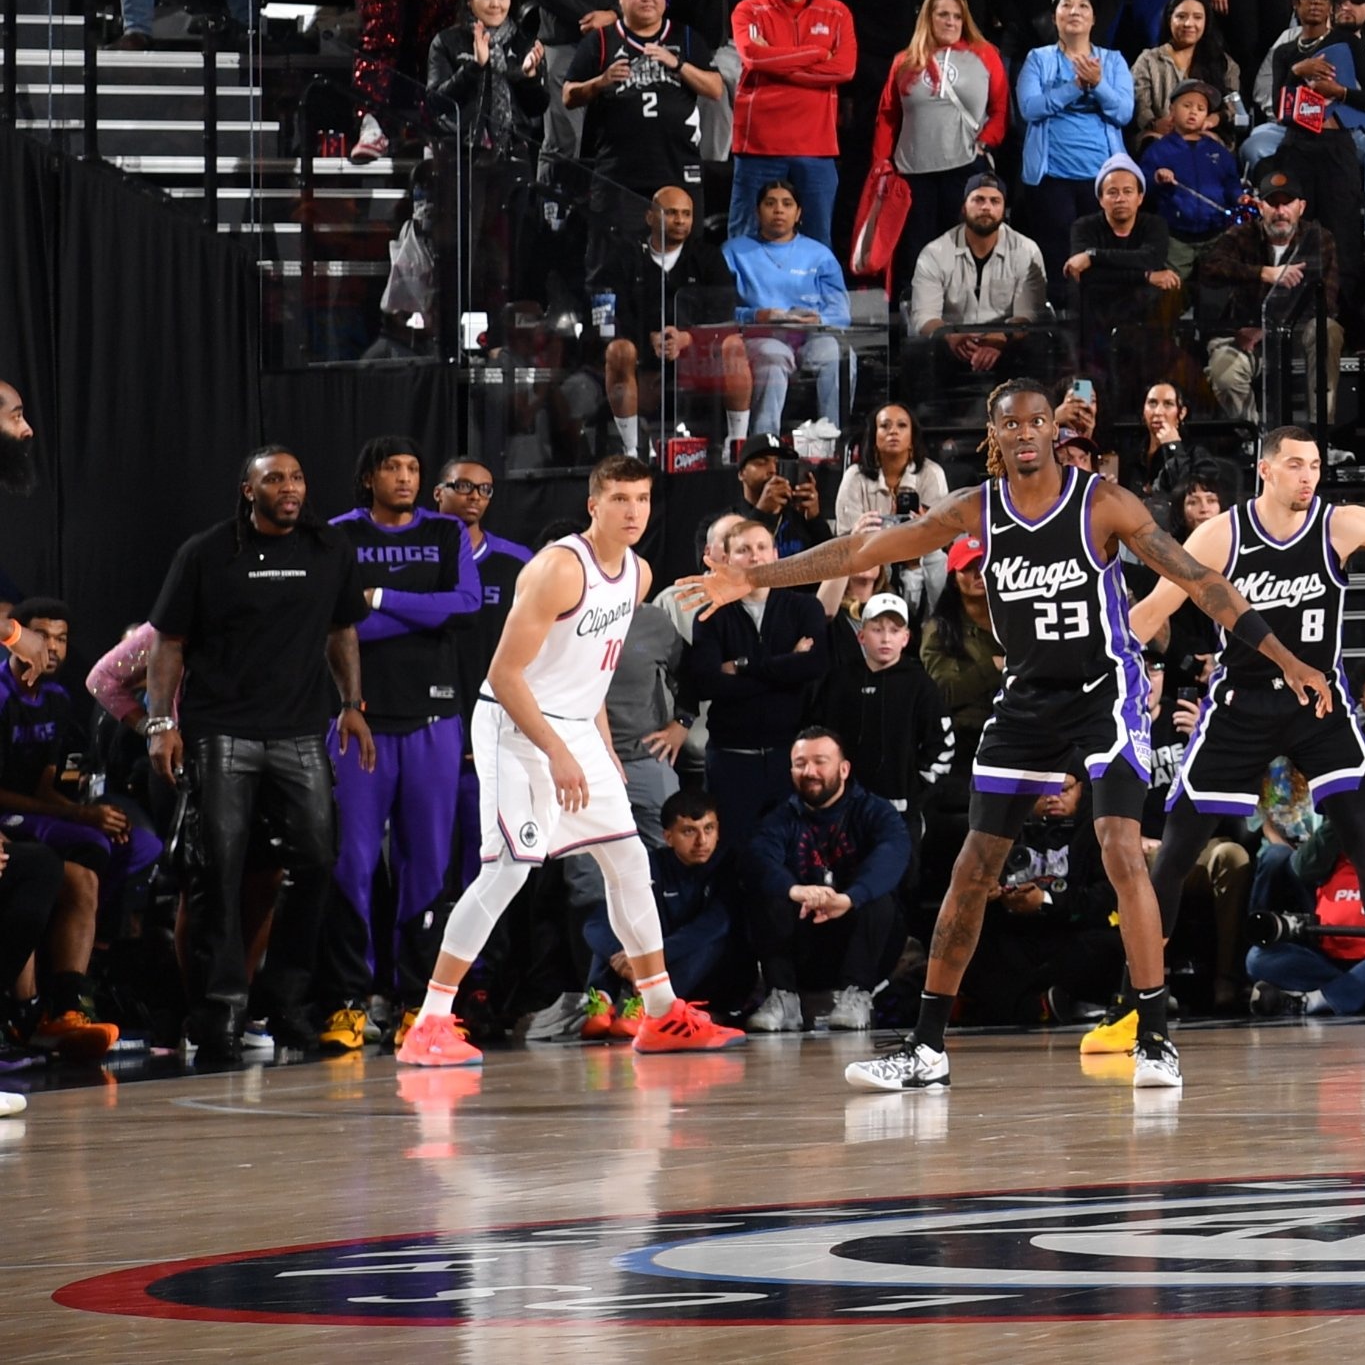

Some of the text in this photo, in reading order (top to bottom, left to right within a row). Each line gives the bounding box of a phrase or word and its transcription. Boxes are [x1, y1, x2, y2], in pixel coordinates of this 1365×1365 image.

[642, 93, 659, 118] 2
[356, 545, 442, 563] KINGS
[990, 555, 1089, 603] Kings
[1233, 567, 1326, 610] Kings
[576, 598, 633, 638] Clippers
[1033, 600, 1090, 641] 23
[1300, 606, 1325, 643] 8
[600, 636, 623, 672] 10
